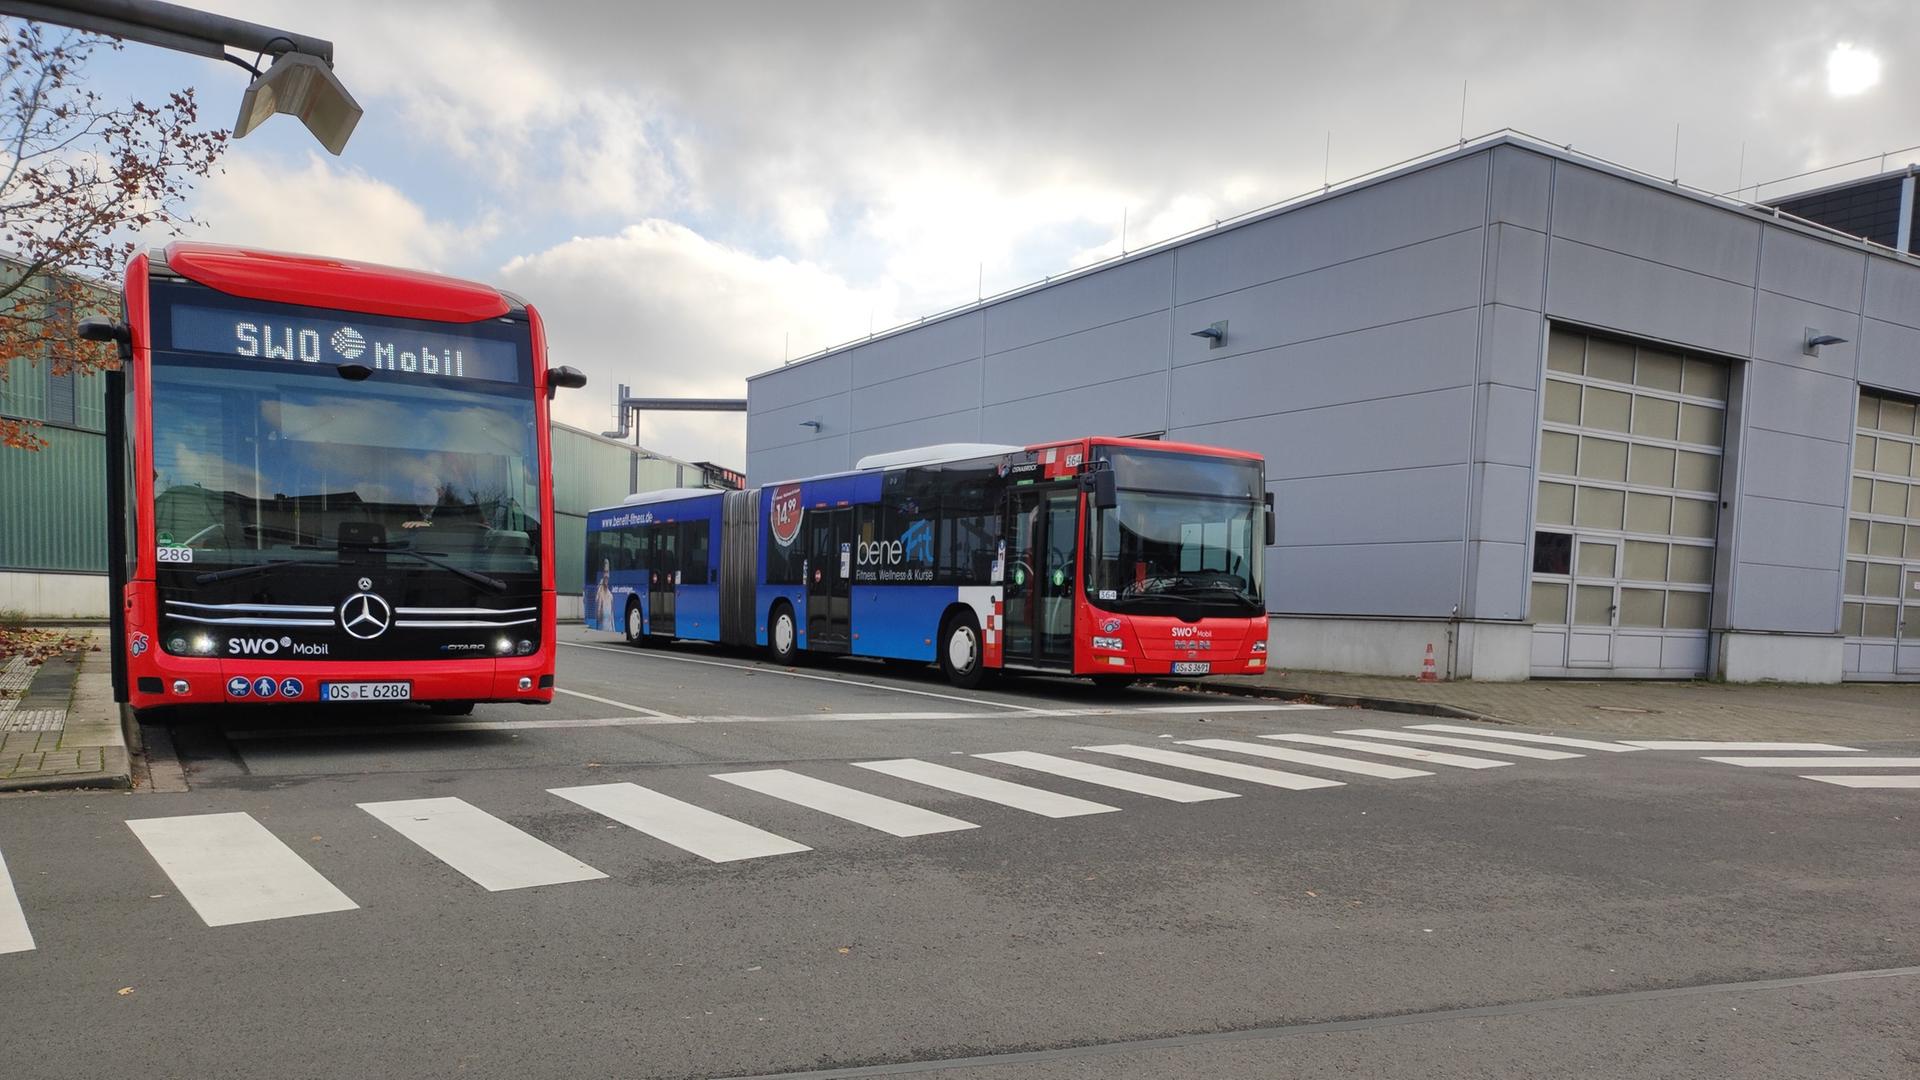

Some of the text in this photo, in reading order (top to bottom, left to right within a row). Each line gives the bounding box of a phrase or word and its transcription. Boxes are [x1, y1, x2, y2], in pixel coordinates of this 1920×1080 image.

[236, 322, 463, 377] SWO Mobil
[159, 548, 191, 562] 286
[914, 569, 934, 580] Kurse
[1171, 627, 1212, 638] SWO Mobil
[228, 637, 329, 655] SWO Mobil
[330, 684, 408, 699] OS E 6286
